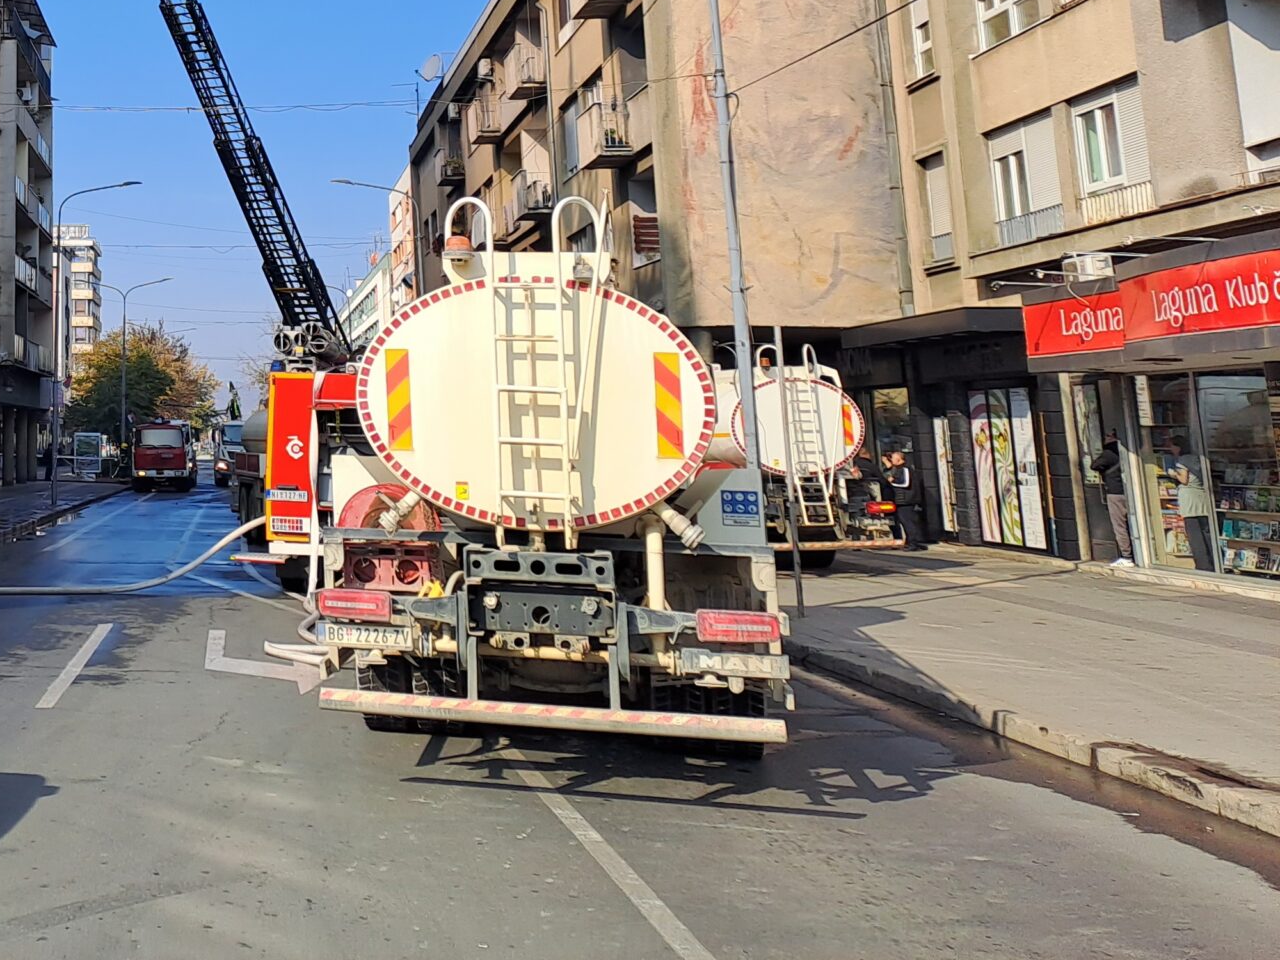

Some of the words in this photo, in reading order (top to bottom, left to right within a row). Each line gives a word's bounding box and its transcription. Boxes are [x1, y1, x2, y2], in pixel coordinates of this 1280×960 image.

[1151, 283, 1218, 327] Laguna
[1225, 272, 1269, 308] Klub
[1059, 306, 1124, 340] Laguna
[327, 626, 345, 641] BG
[699, 654, 772, 673] MAN
